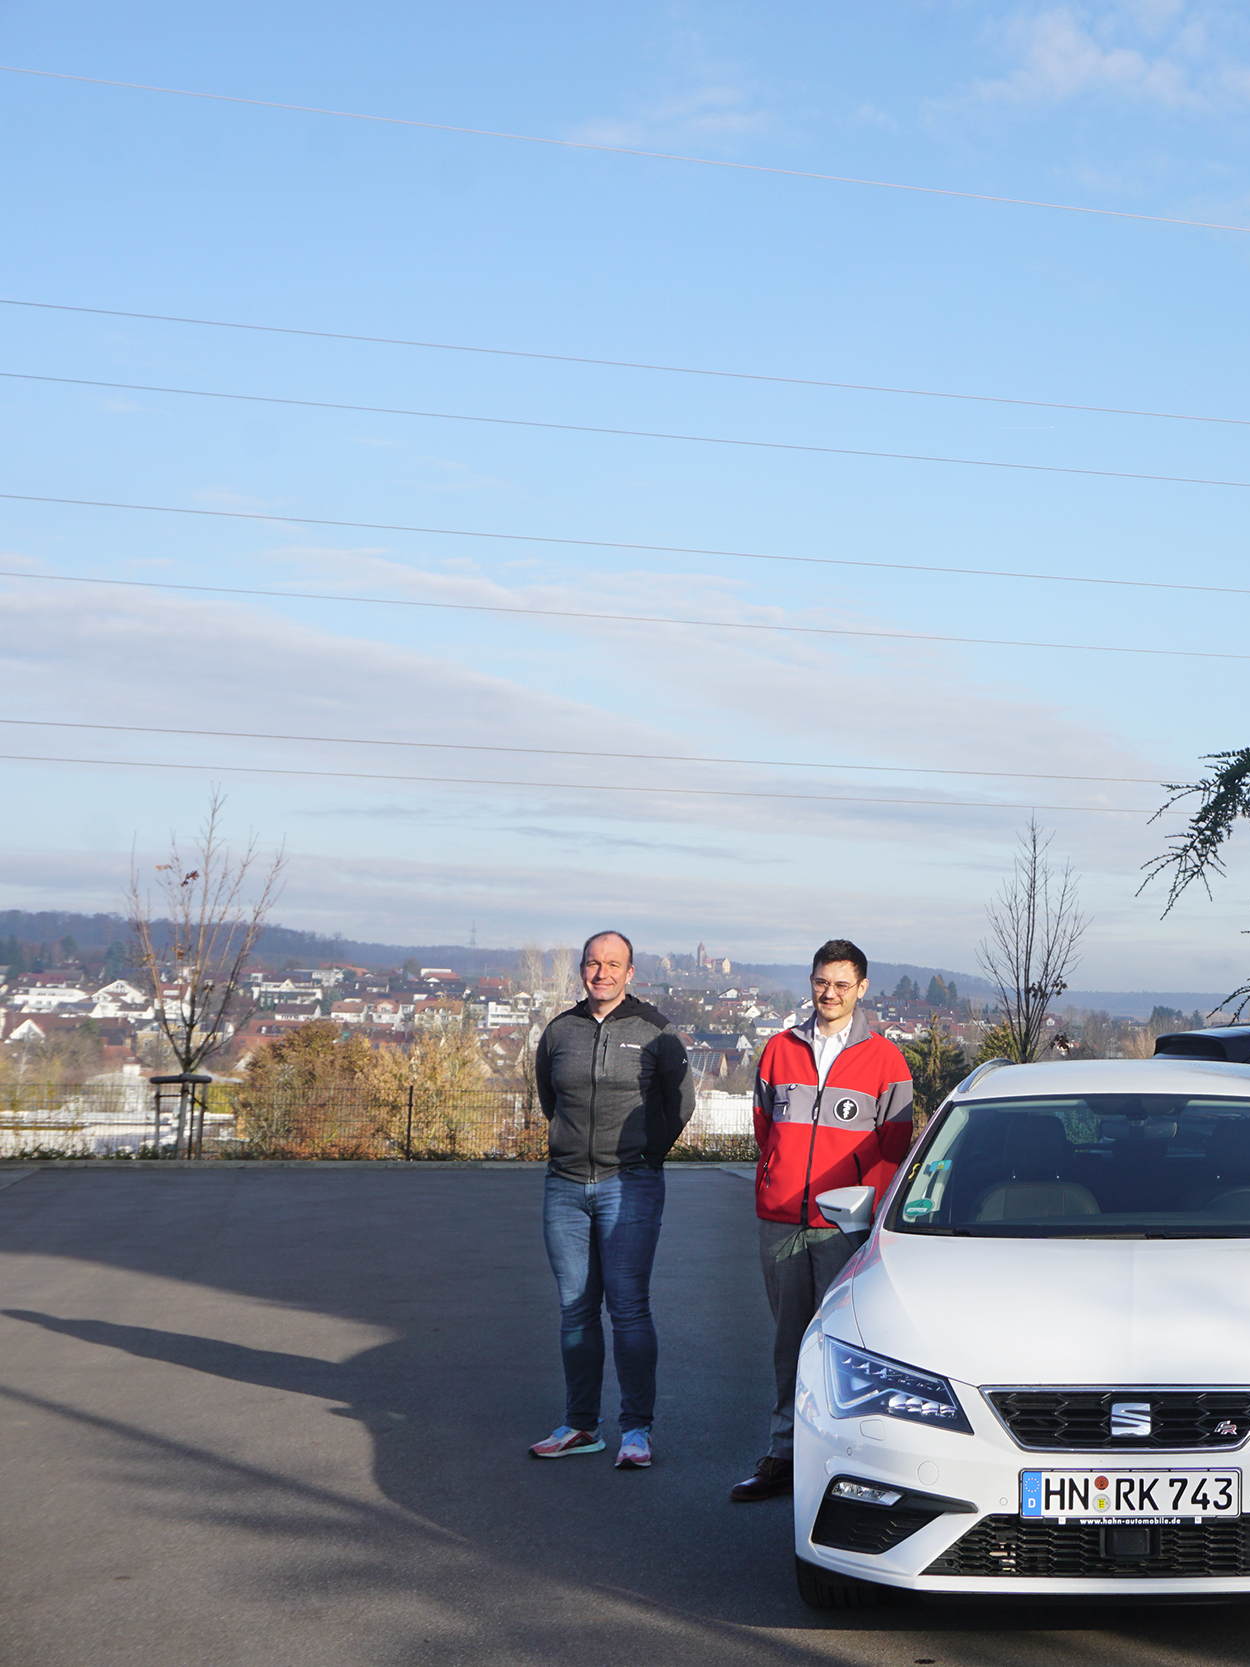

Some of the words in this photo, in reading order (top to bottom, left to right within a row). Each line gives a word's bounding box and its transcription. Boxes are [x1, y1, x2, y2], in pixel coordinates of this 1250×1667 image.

[1044, 1478, 1090, 1511] HN
[1115, 1478, 1159, 1511] RK
[1169, 1478, 1233, 1511] 743
[1028, 1498, 1036, 1508] D
[1079, 1516, 1181, 1525] www.hahn-automobile.de
